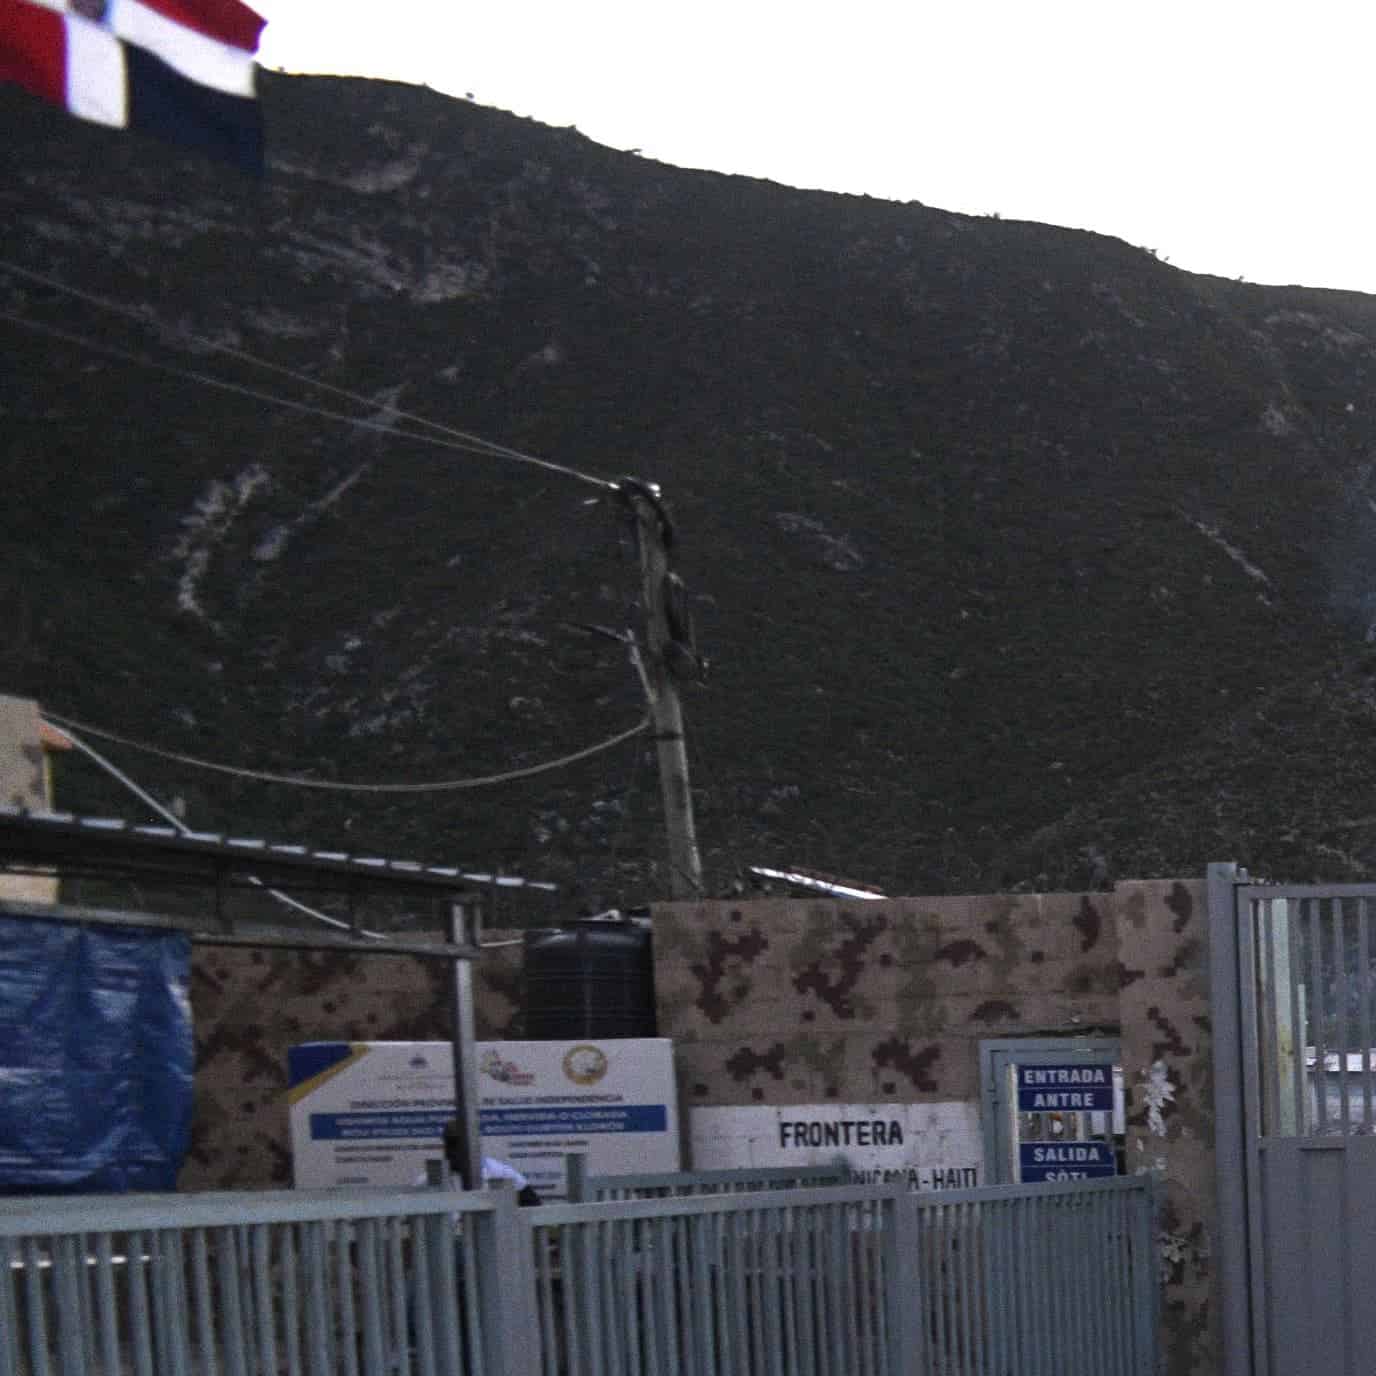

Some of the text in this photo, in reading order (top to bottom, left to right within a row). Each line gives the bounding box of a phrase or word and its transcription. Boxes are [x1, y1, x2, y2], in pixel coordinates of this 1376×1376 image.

[1023, 1069, 1105, 1084] ENTRADA
[1033, 1092, 1095, 1107] ANTRE
[779, 1120, 904, 1147] FRONTERA
[1033, 1147, 1101, 1162] SALIDA
